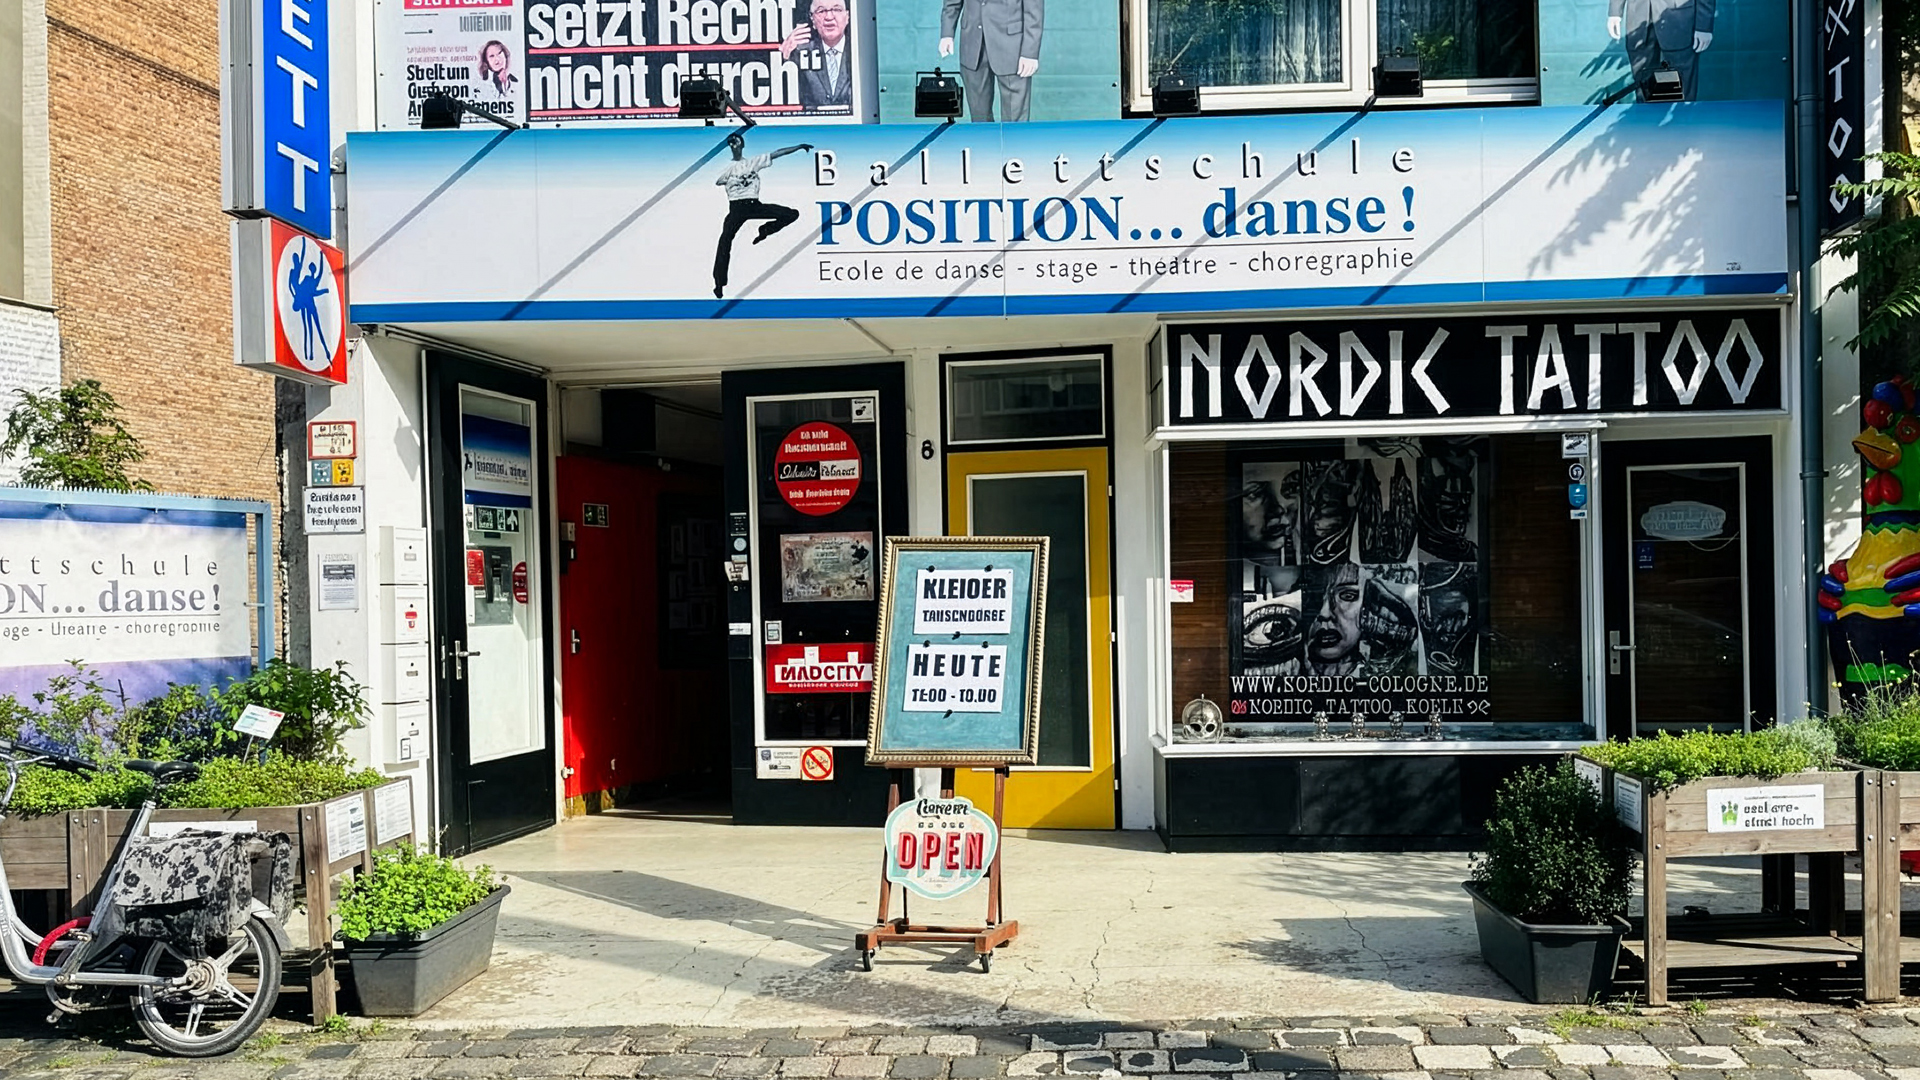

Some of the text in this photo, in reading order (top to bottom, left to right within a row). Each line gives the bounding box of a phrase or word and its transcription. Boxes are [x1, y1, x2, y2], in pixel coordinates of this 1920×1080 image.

[528, 0, 797, 49] setzt Recht
[529, 54, 650, 111] nicht
[814, 138, 1415, 188] Ballettschule
[815, 195, 1183, 246] POSITION...
[819, 260, 884, 281] Ecole
[895, 259, 924, 279] de
[935, 259, 1004, 279] danse
[1036, 259, 1098, 283] stage
[1179, 318, 1764, 420] NORDIC TATTOO
[912, 653, 1002, 678] HEUTE
[897, 832, 984, 870] OPEN
